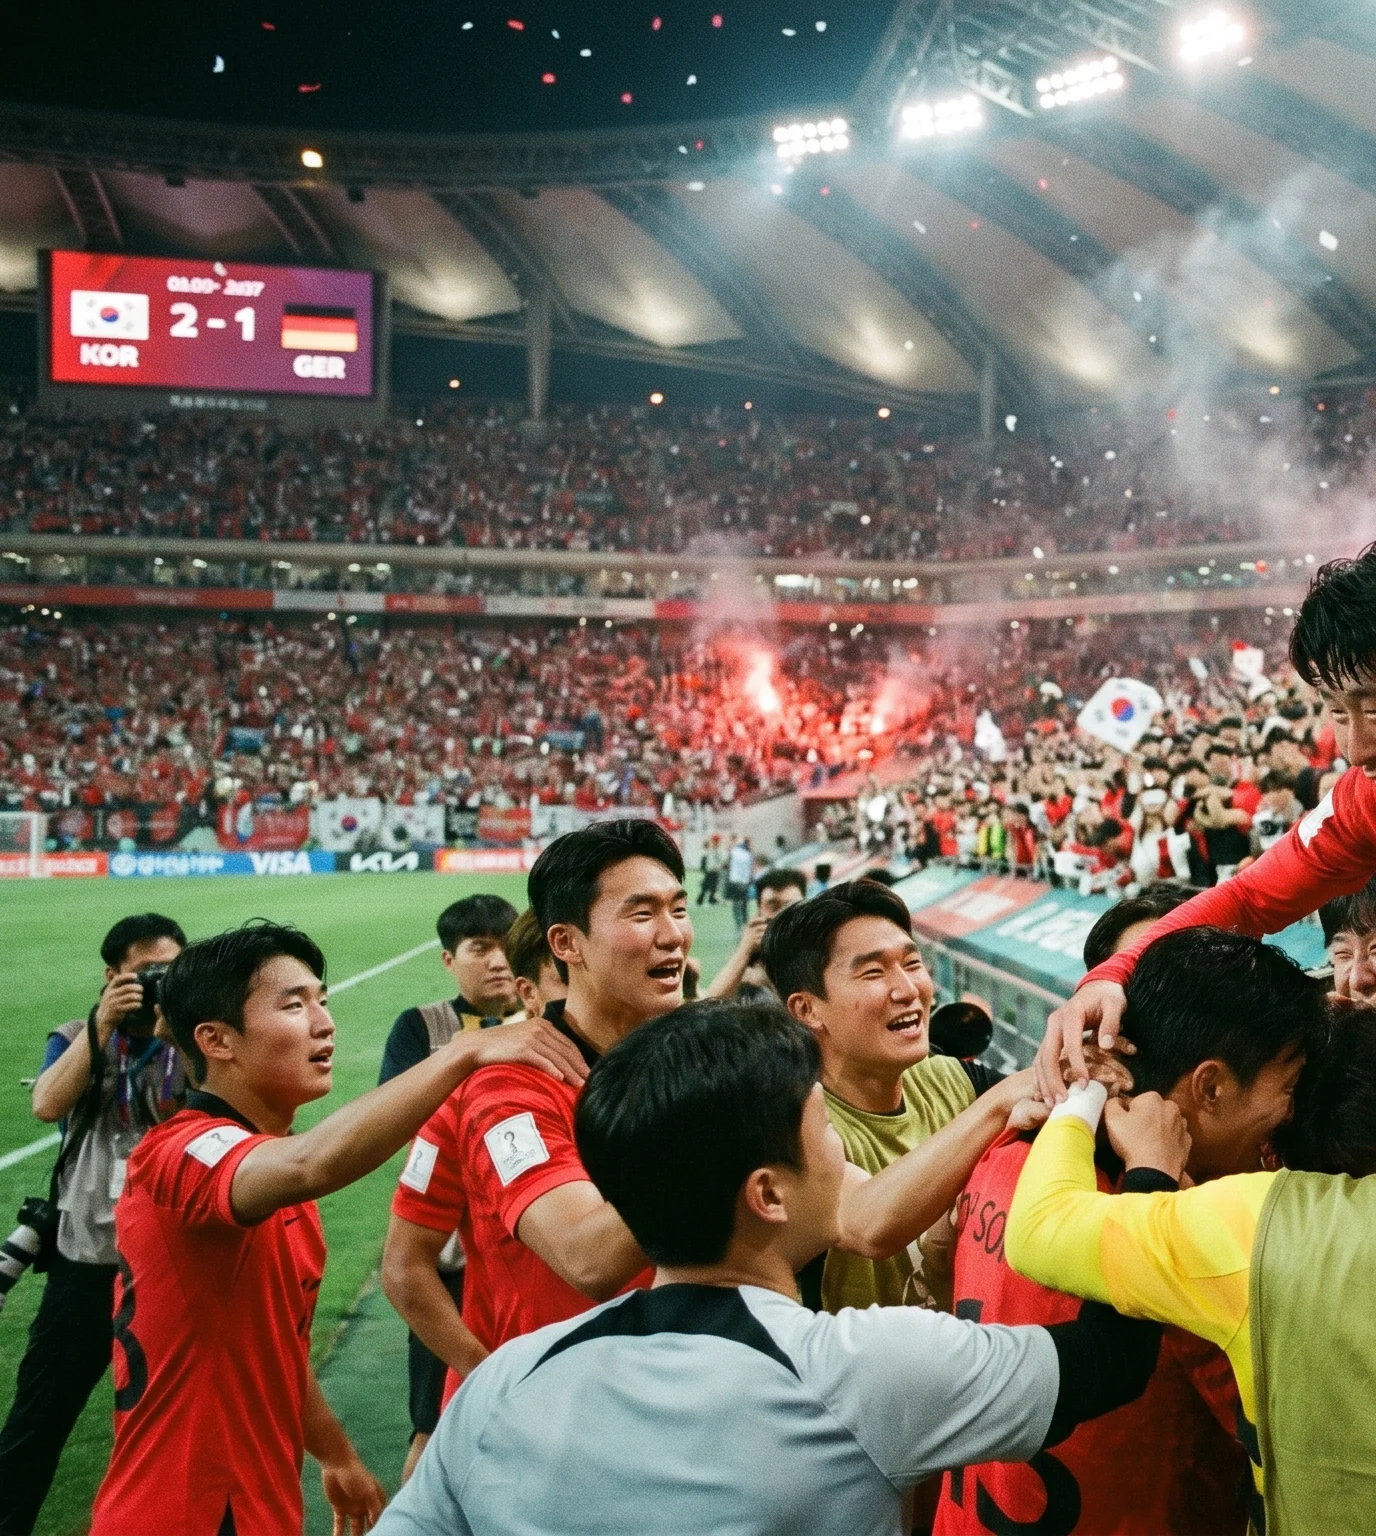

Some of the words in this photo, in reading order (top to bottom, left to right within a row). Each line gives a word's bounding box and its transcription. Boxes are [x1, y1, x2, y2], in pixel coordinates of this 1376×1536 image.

[169, 302, 199, 339] 2
[234, 306, 256, 342] 1
[79, 343, 140, 368] KOR
[292, 354, 347, 380] GER
[250, 851, 311, 875] VISA
